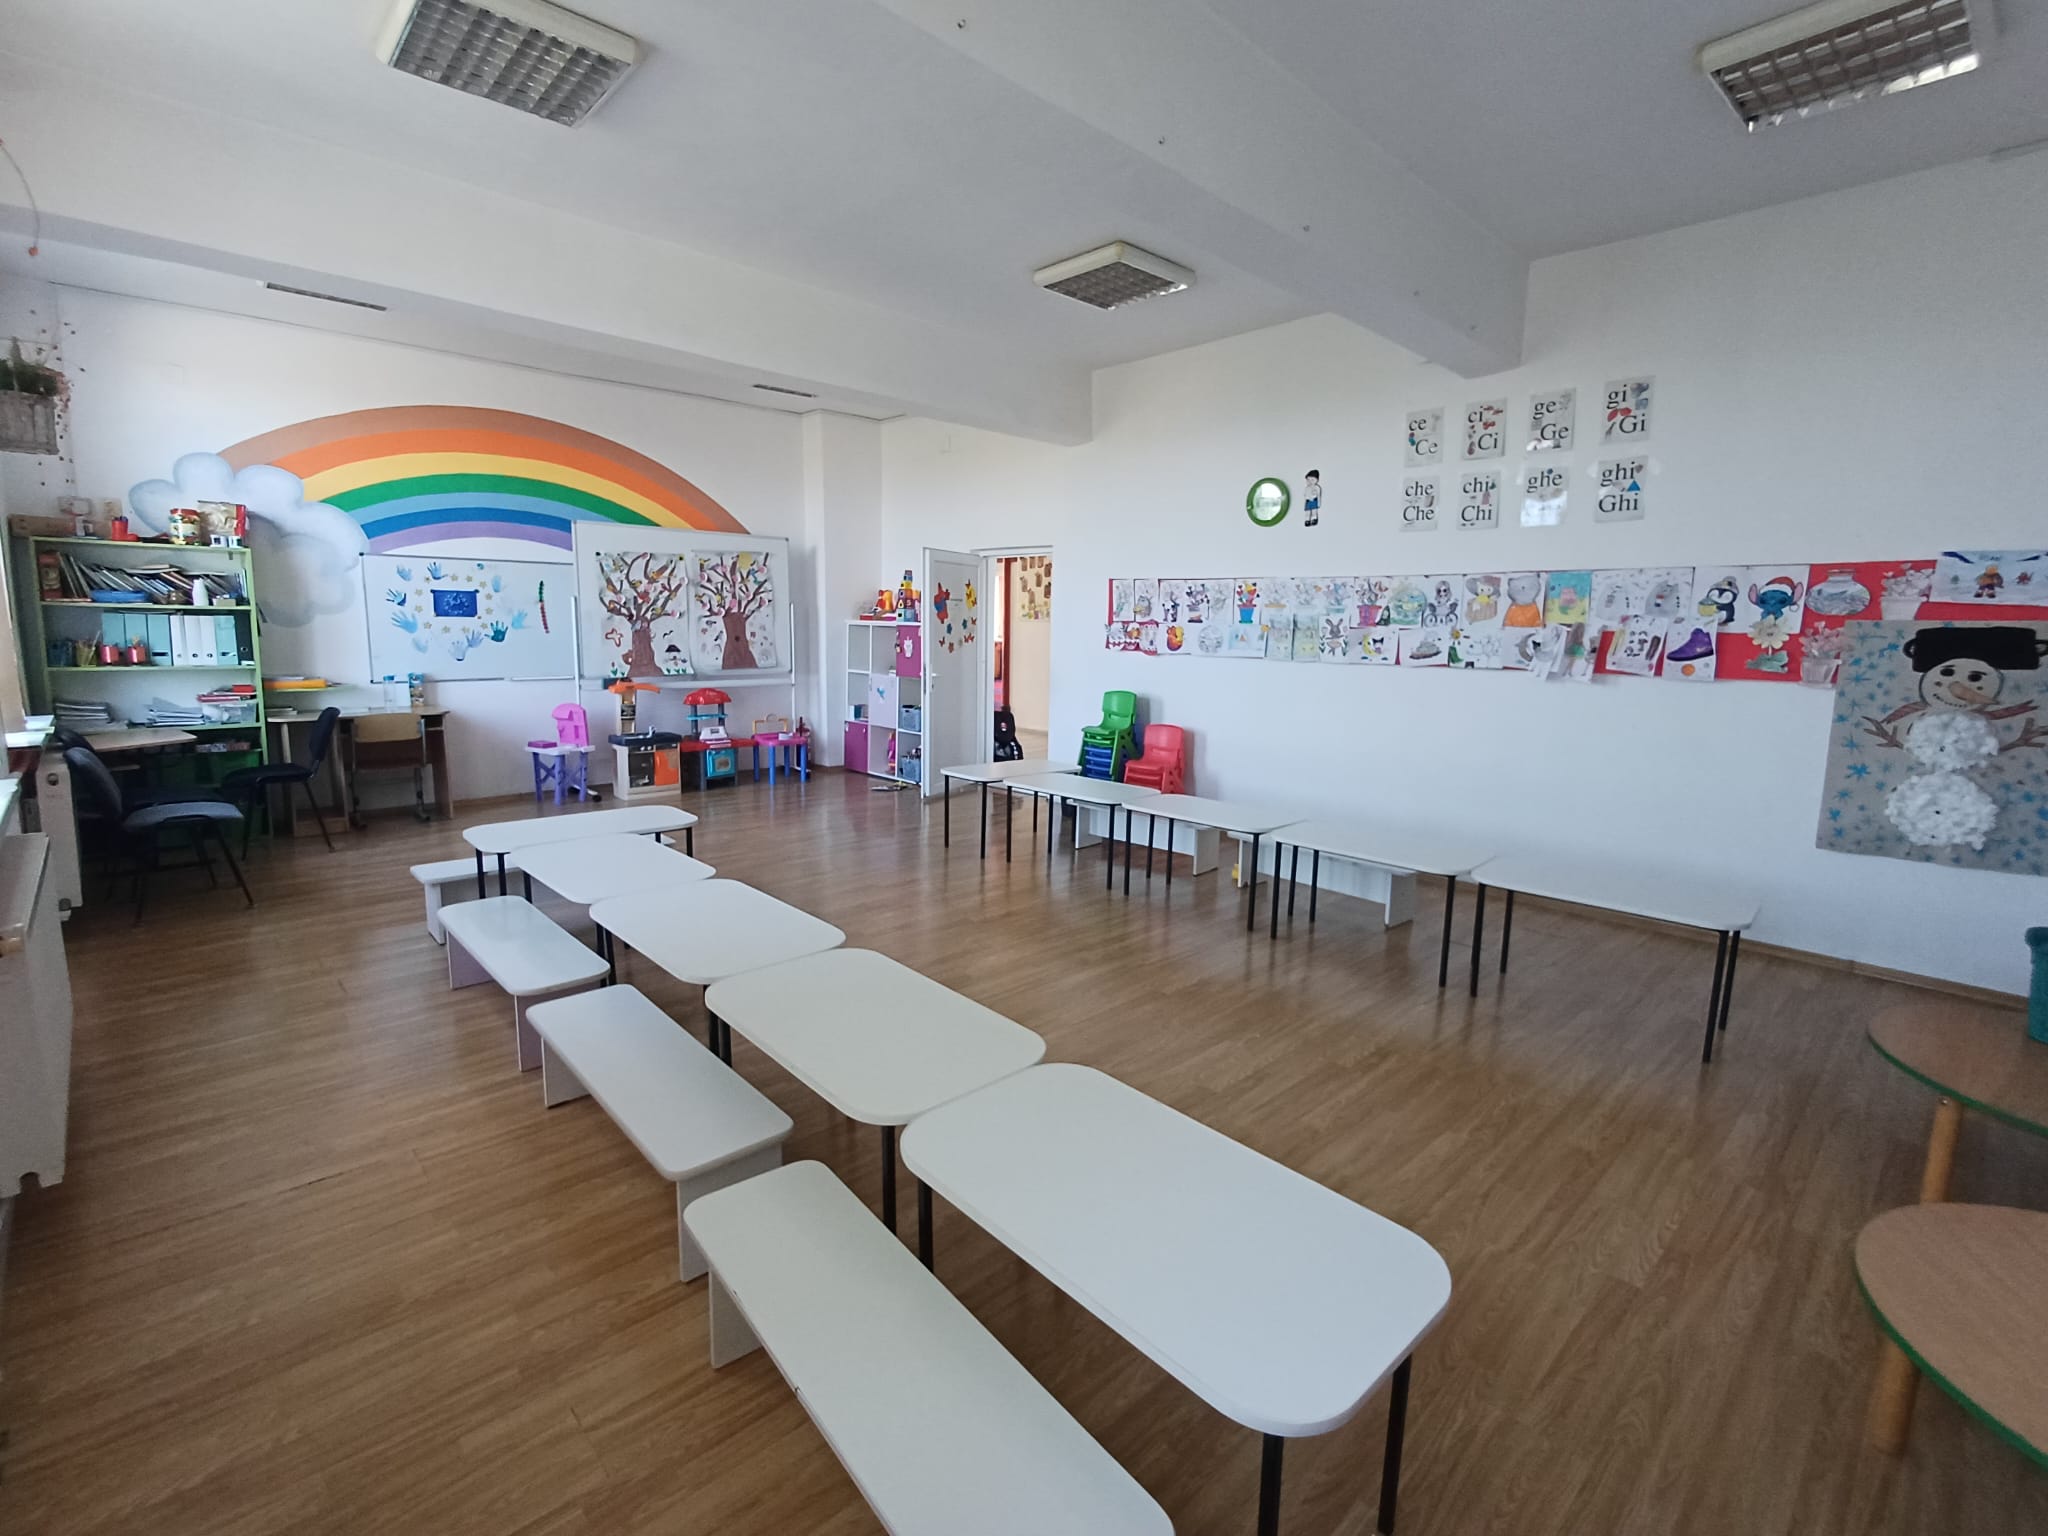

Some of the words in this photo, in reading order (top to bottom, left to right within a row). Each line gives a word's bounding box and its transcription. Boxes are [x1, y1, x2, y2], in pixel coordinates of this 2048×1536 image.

[1606, 384, 1627, 410] gi
[1468, 406, 1483, 423] ci
[1533, 400, 1557, 420] ge
[1408, 418, 1427, 431] ce
[1540, 423, 1569, 441] Ge
[1619, 413, 1646, 433] Gi
[1415, 439, 1438, 456] Ce
[1477, 432, 1499, 450] Ci
[1526, 471, 1563, 493] ghe
[1600, 461, 1636, 487] ghi
[1405, 481, 1434, 497] che
[1463, 475, 1488, 494] chi
[1598, 492, 1639, 513] Ghi
[1403, 505, 1435, 521] Che
[1461, 503, 1492, 522] Chi
